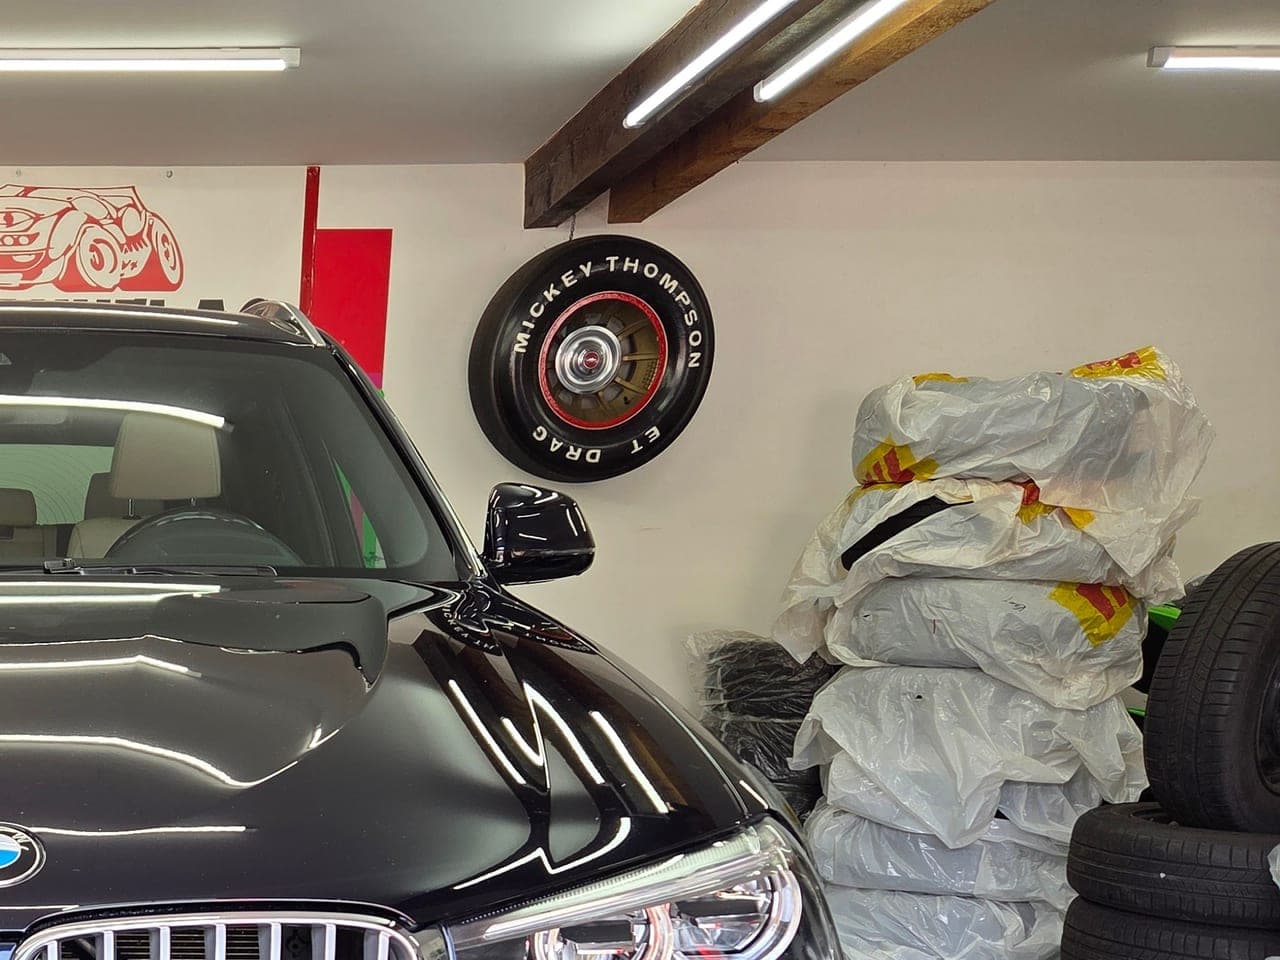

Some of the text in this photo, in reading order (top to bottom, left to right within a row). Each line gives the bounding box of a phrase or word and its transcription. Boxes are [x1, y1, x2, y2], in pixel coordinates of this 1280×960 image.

[513, 255, 703, 369] MICKEY THOMPSON
[531, 424, 662, 464] ET DRAG
